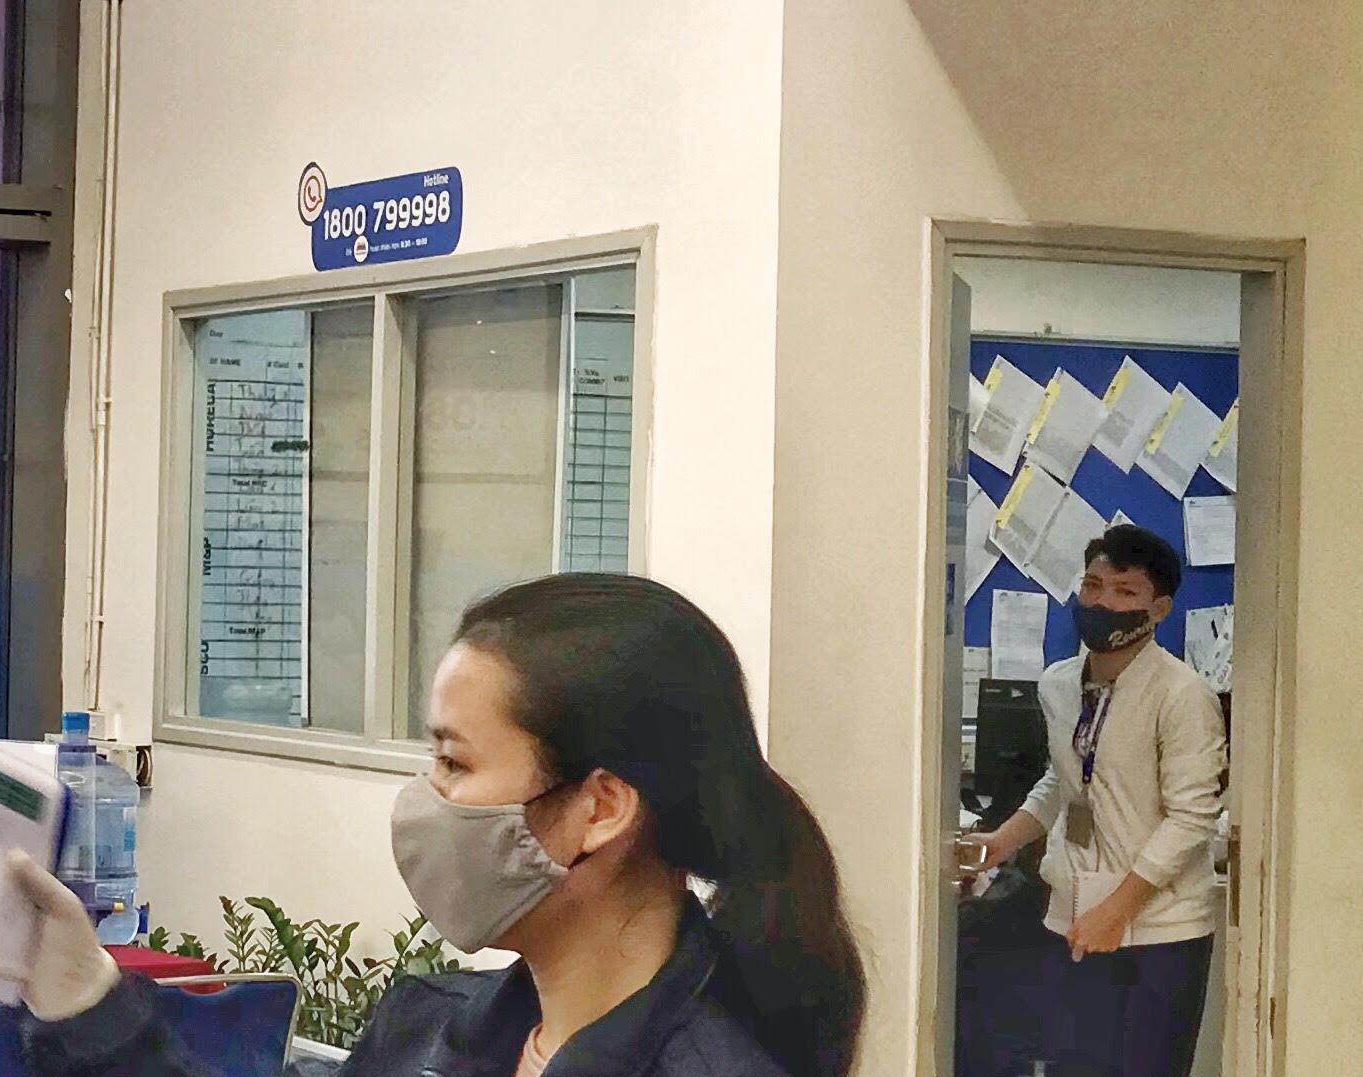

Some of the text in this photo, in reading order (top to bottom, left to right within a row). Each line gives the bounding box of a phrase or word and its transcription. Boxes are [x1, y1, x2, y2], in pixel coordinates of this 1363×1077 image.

[423, 173, 450, 188] Hotline
[323, 190, 451, 240] 1800 799998
